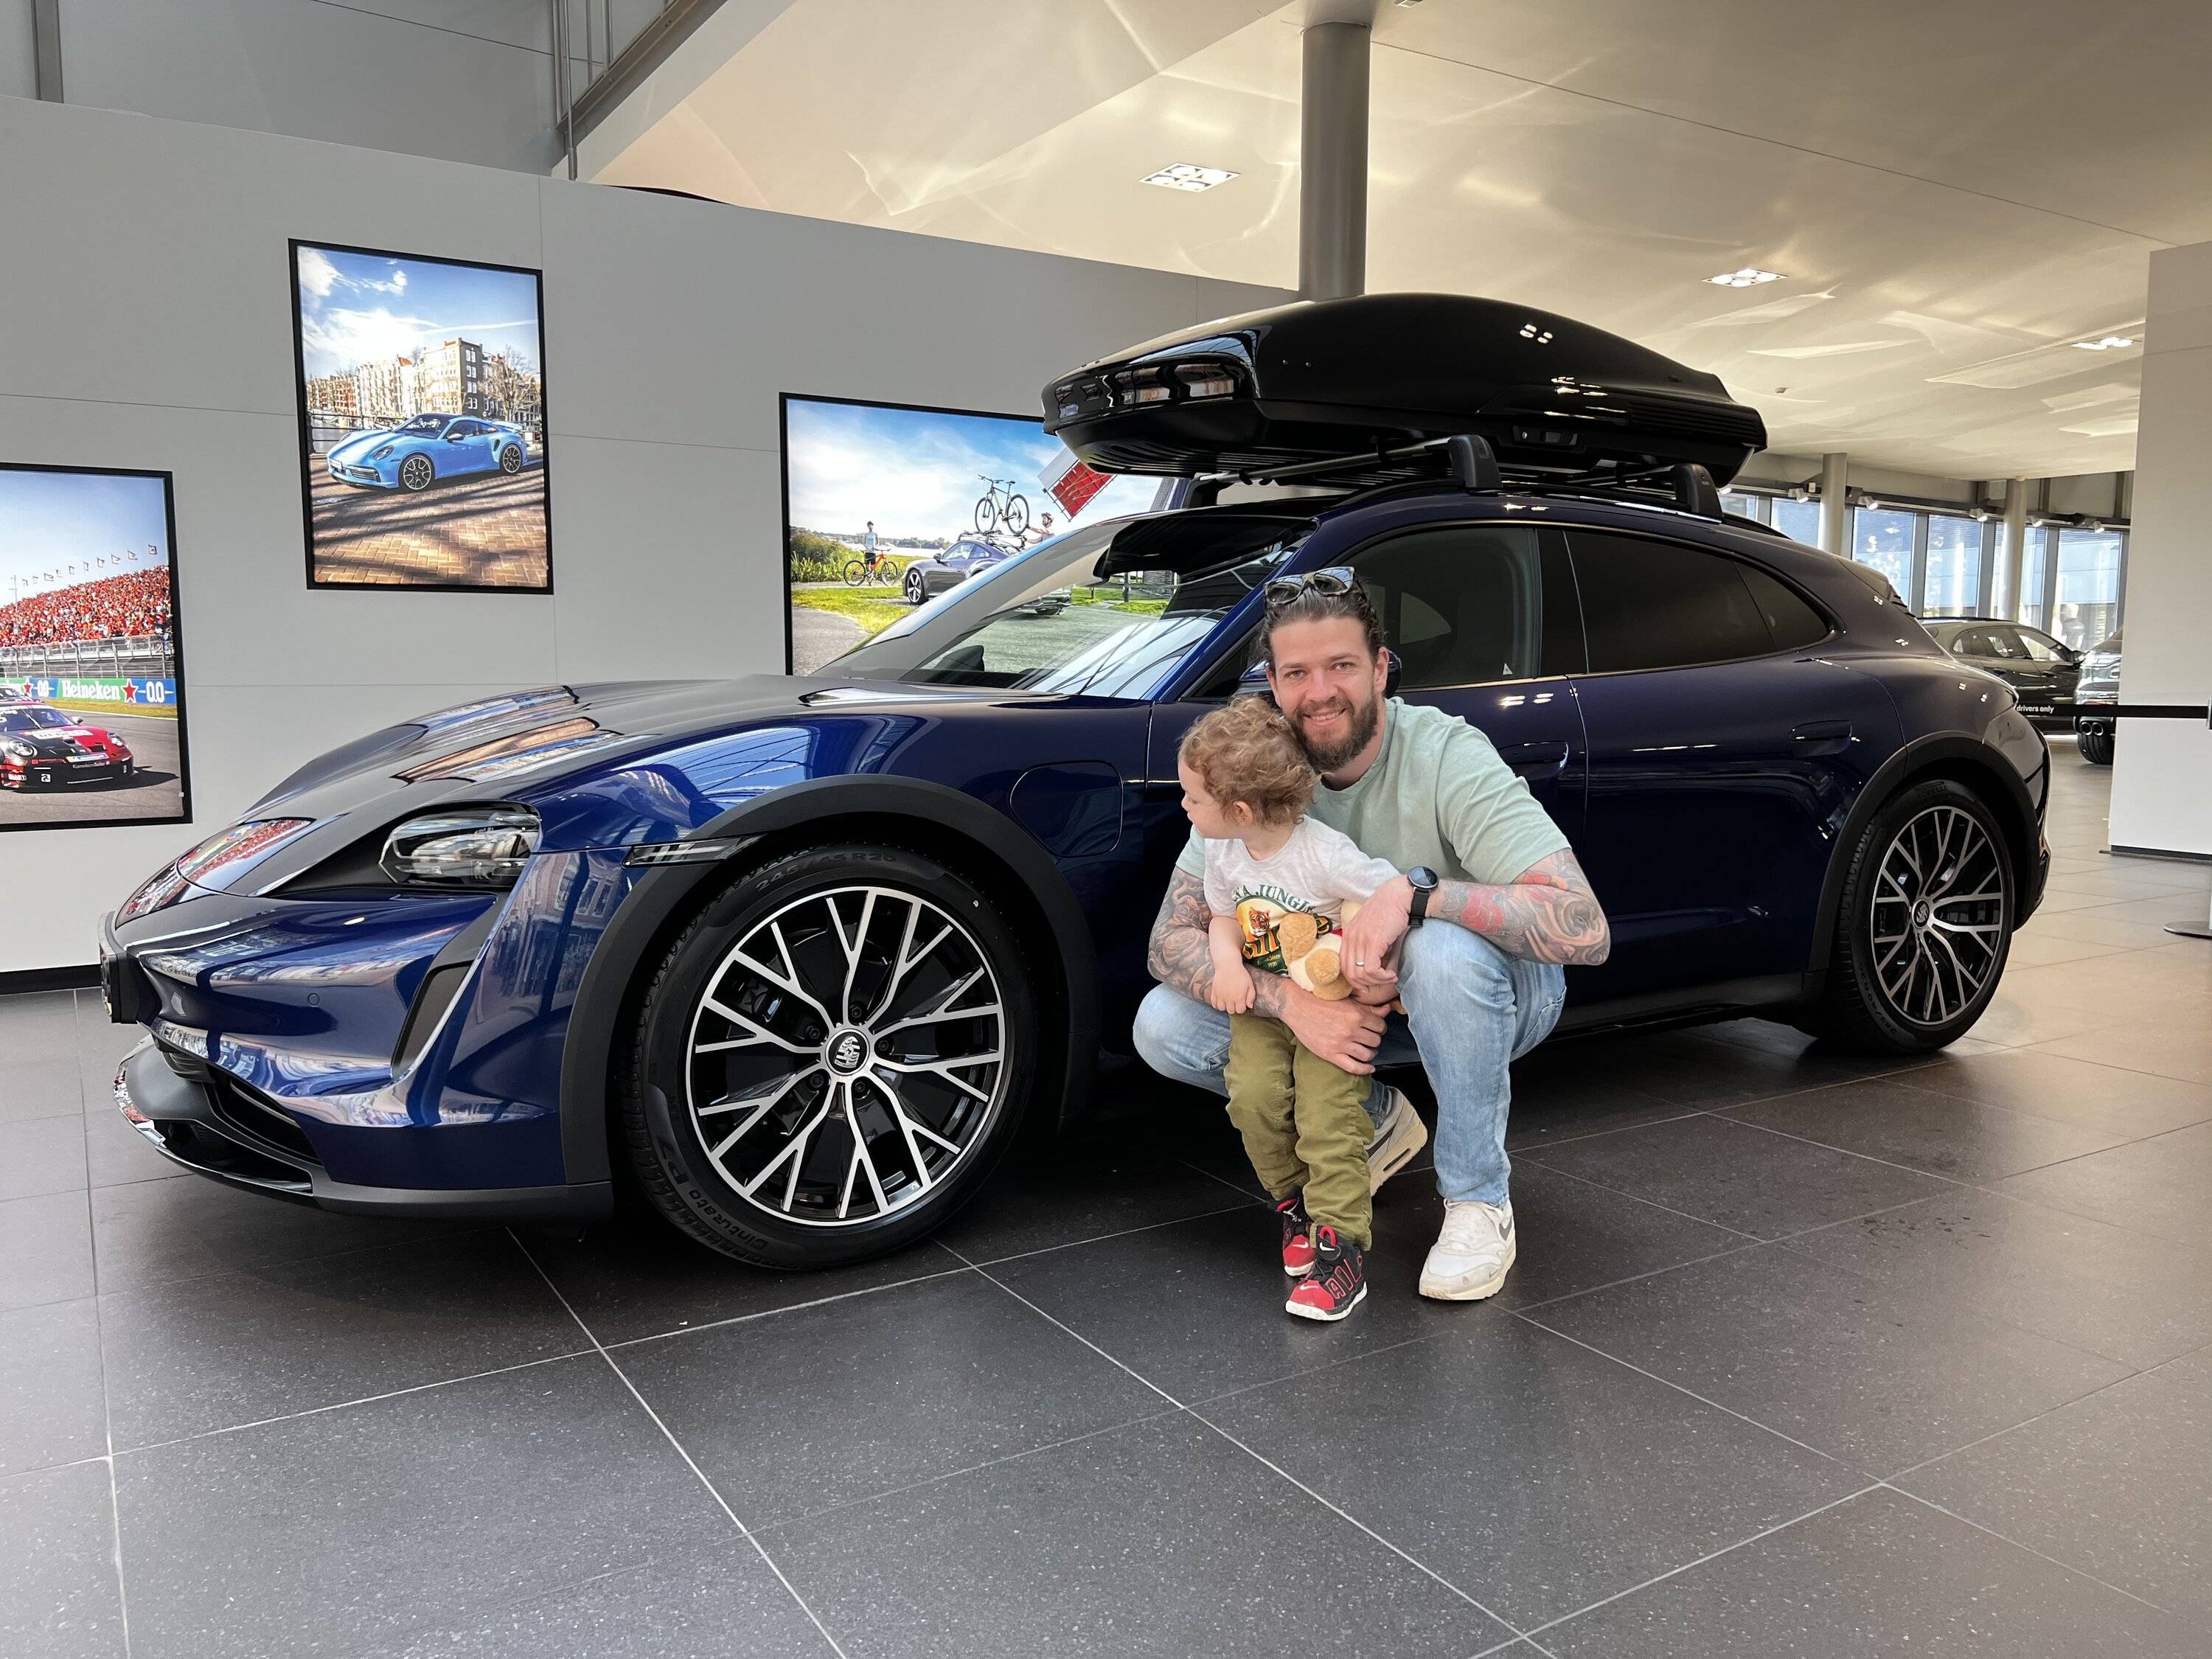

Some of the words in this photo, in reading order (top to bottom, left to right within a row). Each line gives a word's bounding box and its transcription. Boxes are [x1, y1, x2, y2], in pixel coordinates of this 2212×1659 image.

[62, 680, 121, 700] Heineken
[146, 681, 164, 703] 0.0
[2039, 706, 2054, 714] only
[689, 1189, 768, 1250] Cinturato
